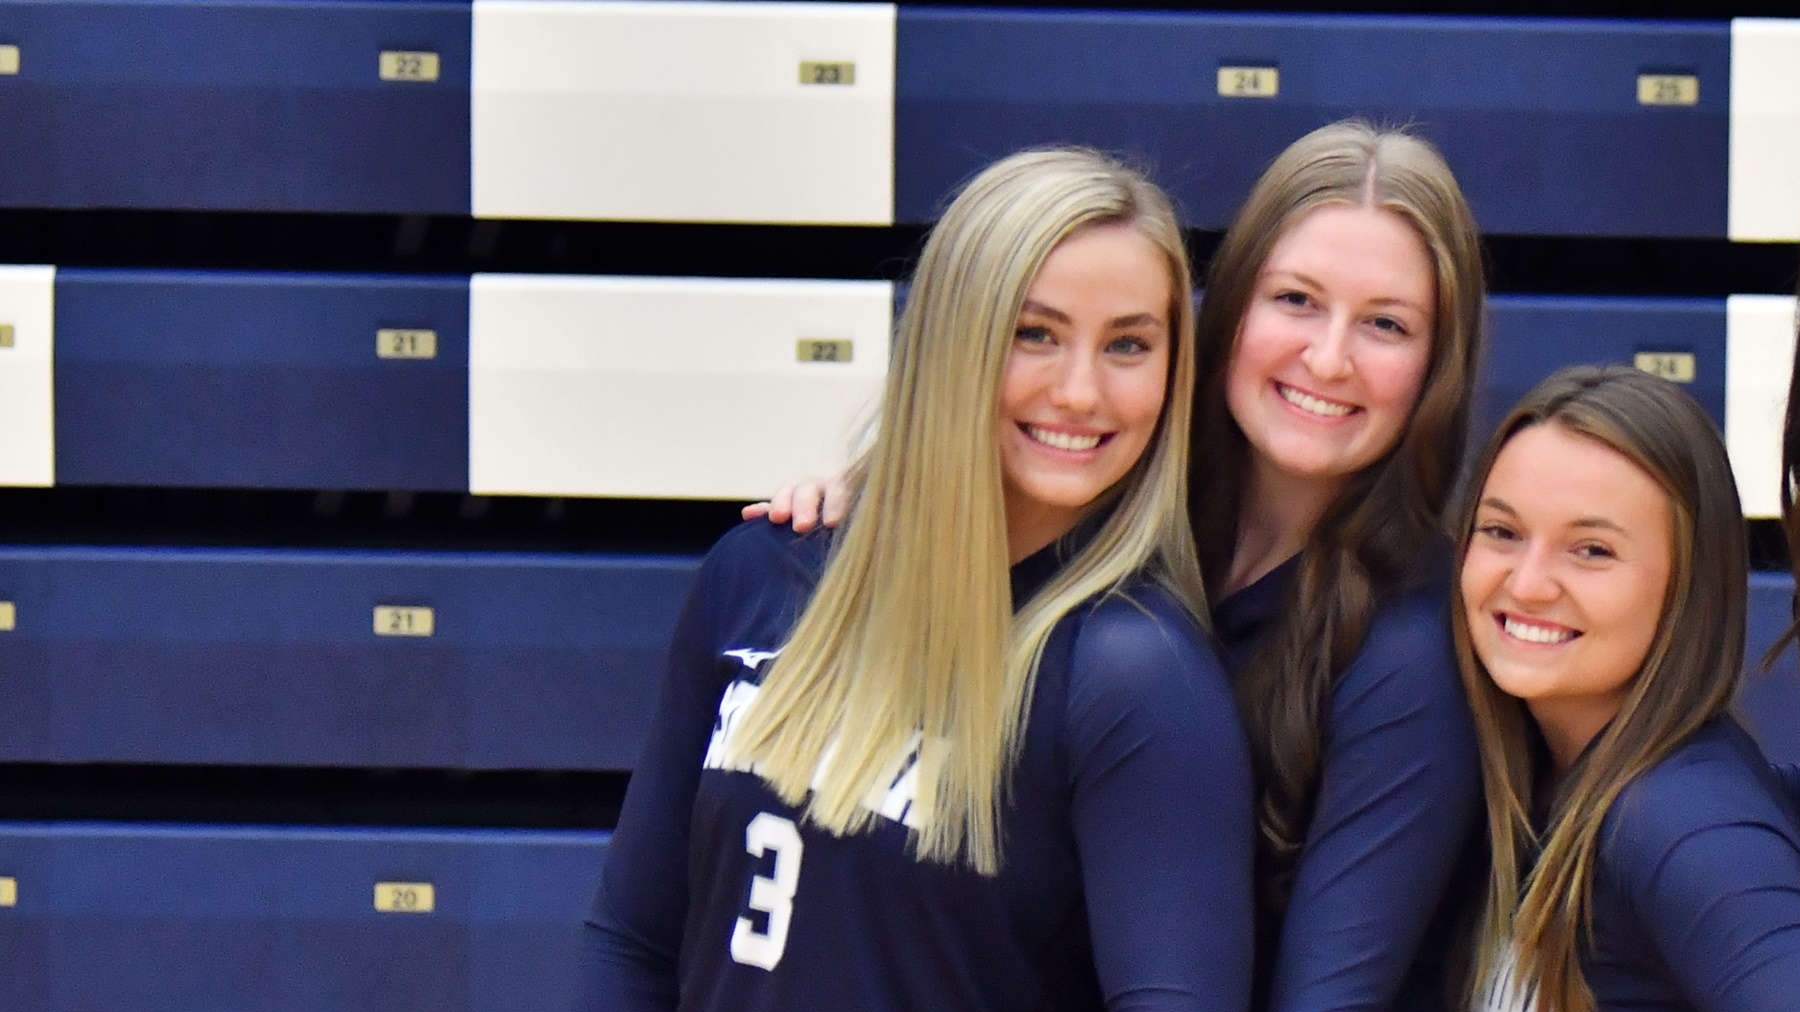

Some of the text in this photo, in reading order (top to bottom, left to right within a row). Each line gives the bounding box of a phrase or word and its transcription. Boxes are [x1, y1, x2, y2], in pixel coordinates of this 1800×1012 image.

[396, 56, 421, 75] 22
[814, 64, 840, 84] 23
[1235, 71, 1260, 90] 24
[1655, 79, 1680, 99] 25
[394, 334, 415, 353] 21
[812, 342, 837, 361] 22
[1652, 357, 1676, 375] 24
[390, 612, 413, 630] 21
[391, 889, 416, 908] 20
[730, 811, 804, 971] 3
